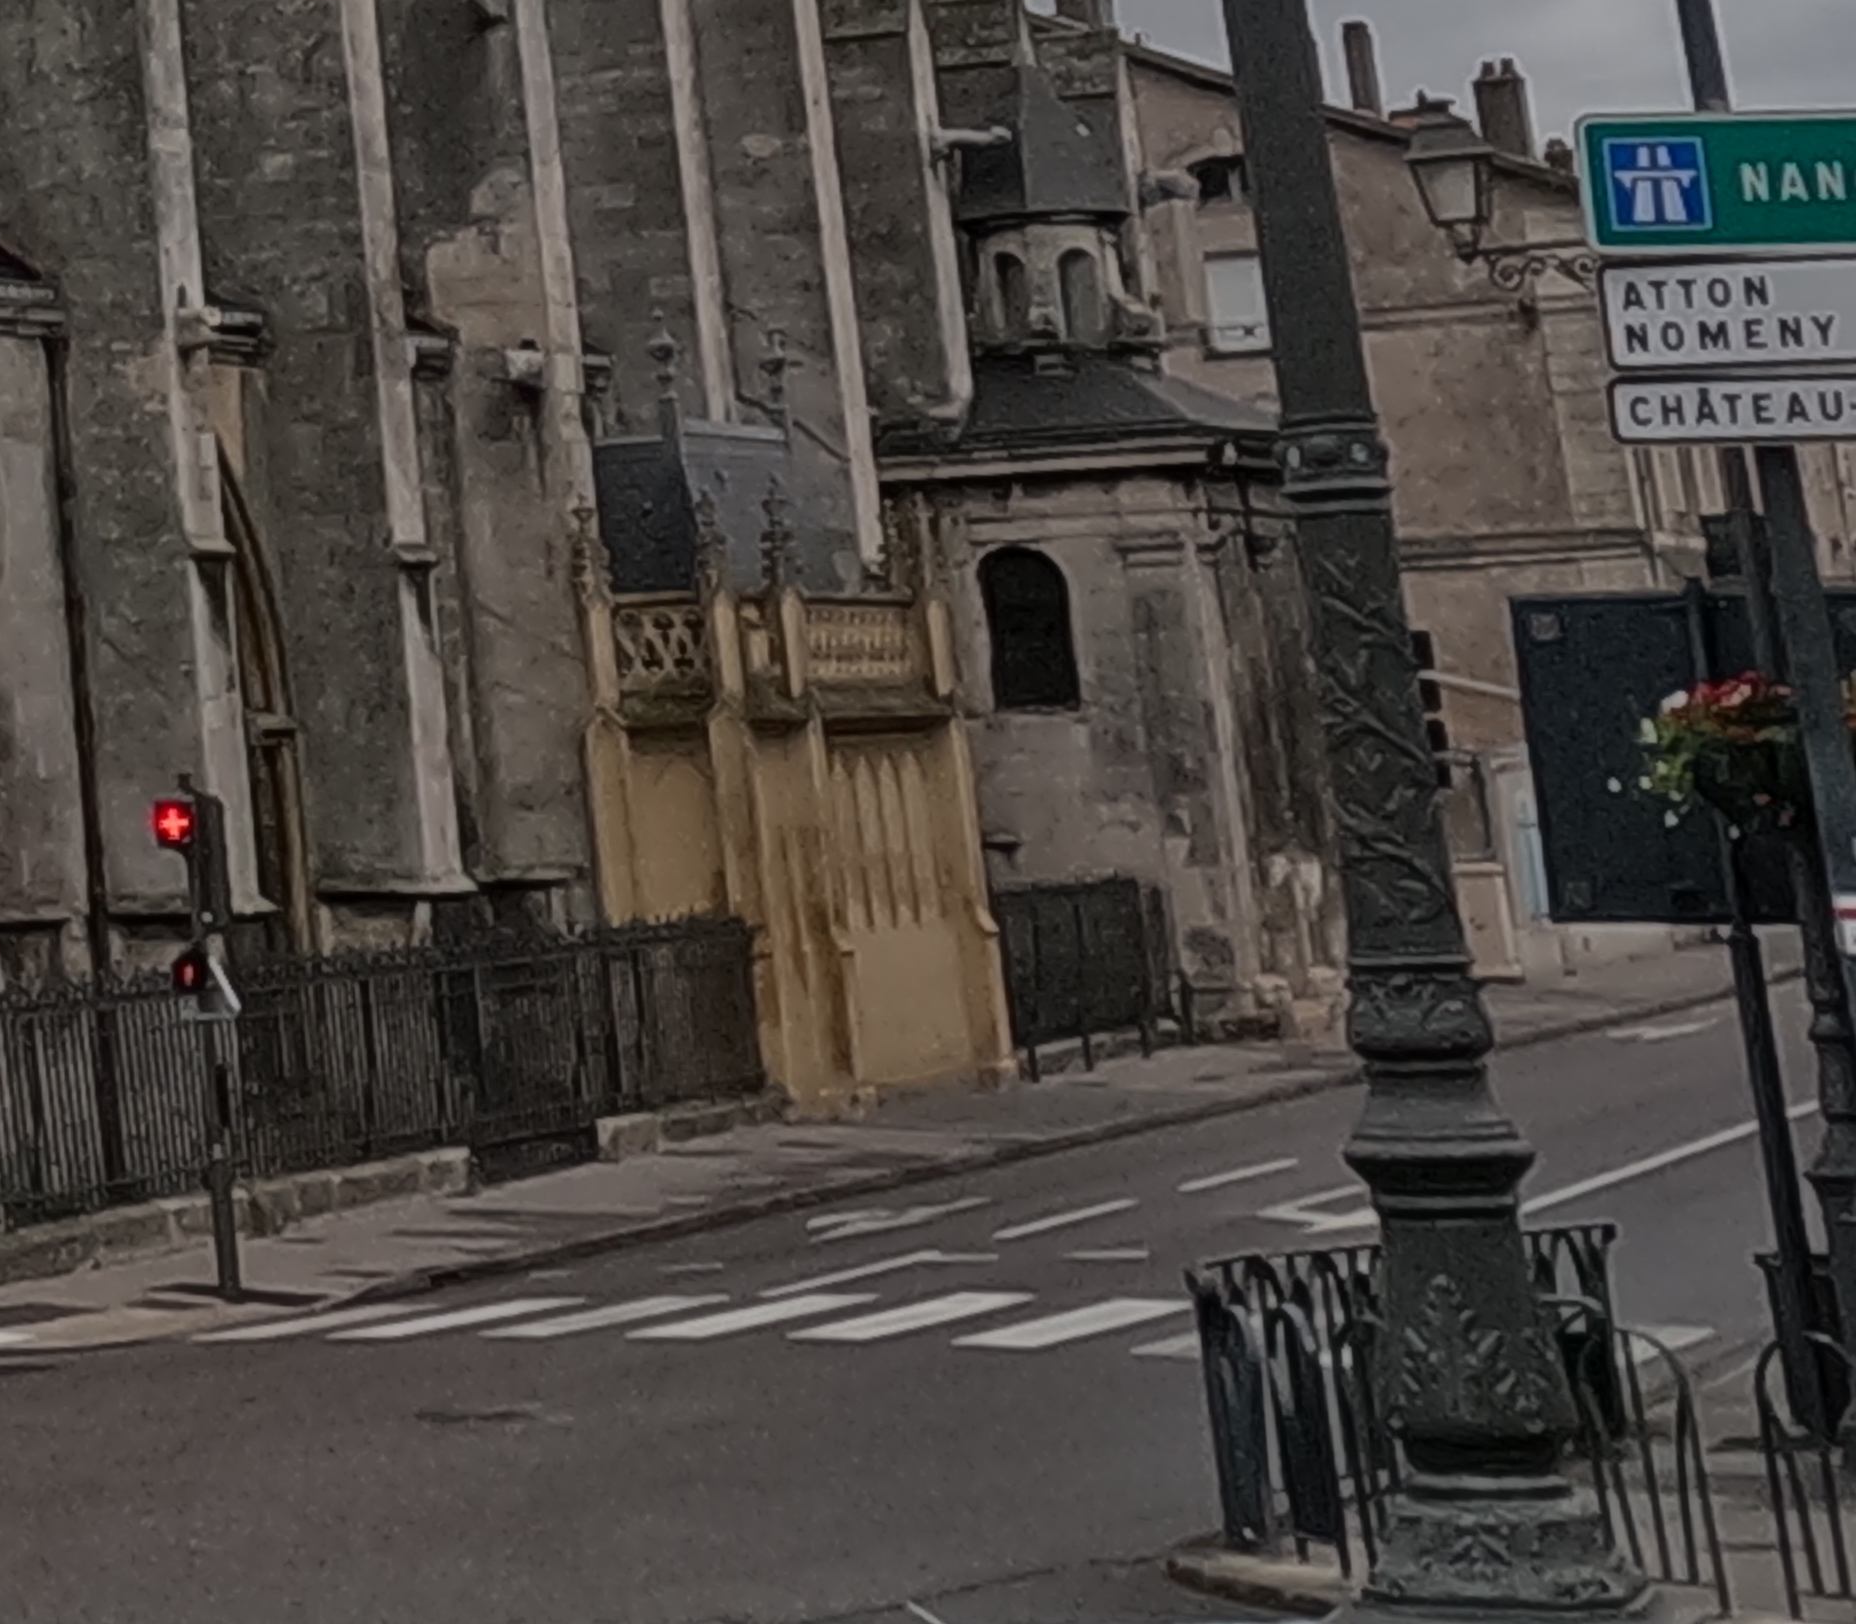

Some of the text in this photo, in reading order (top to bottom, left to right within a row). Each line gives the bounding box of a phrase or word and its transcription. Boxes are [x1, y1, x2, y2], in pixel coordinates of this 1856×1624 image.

[1738, 160, 1856, 203] NAN
[1622, 275, 1770, 312] ATTON
[1623, 314, 1836, 354] NOMENY
